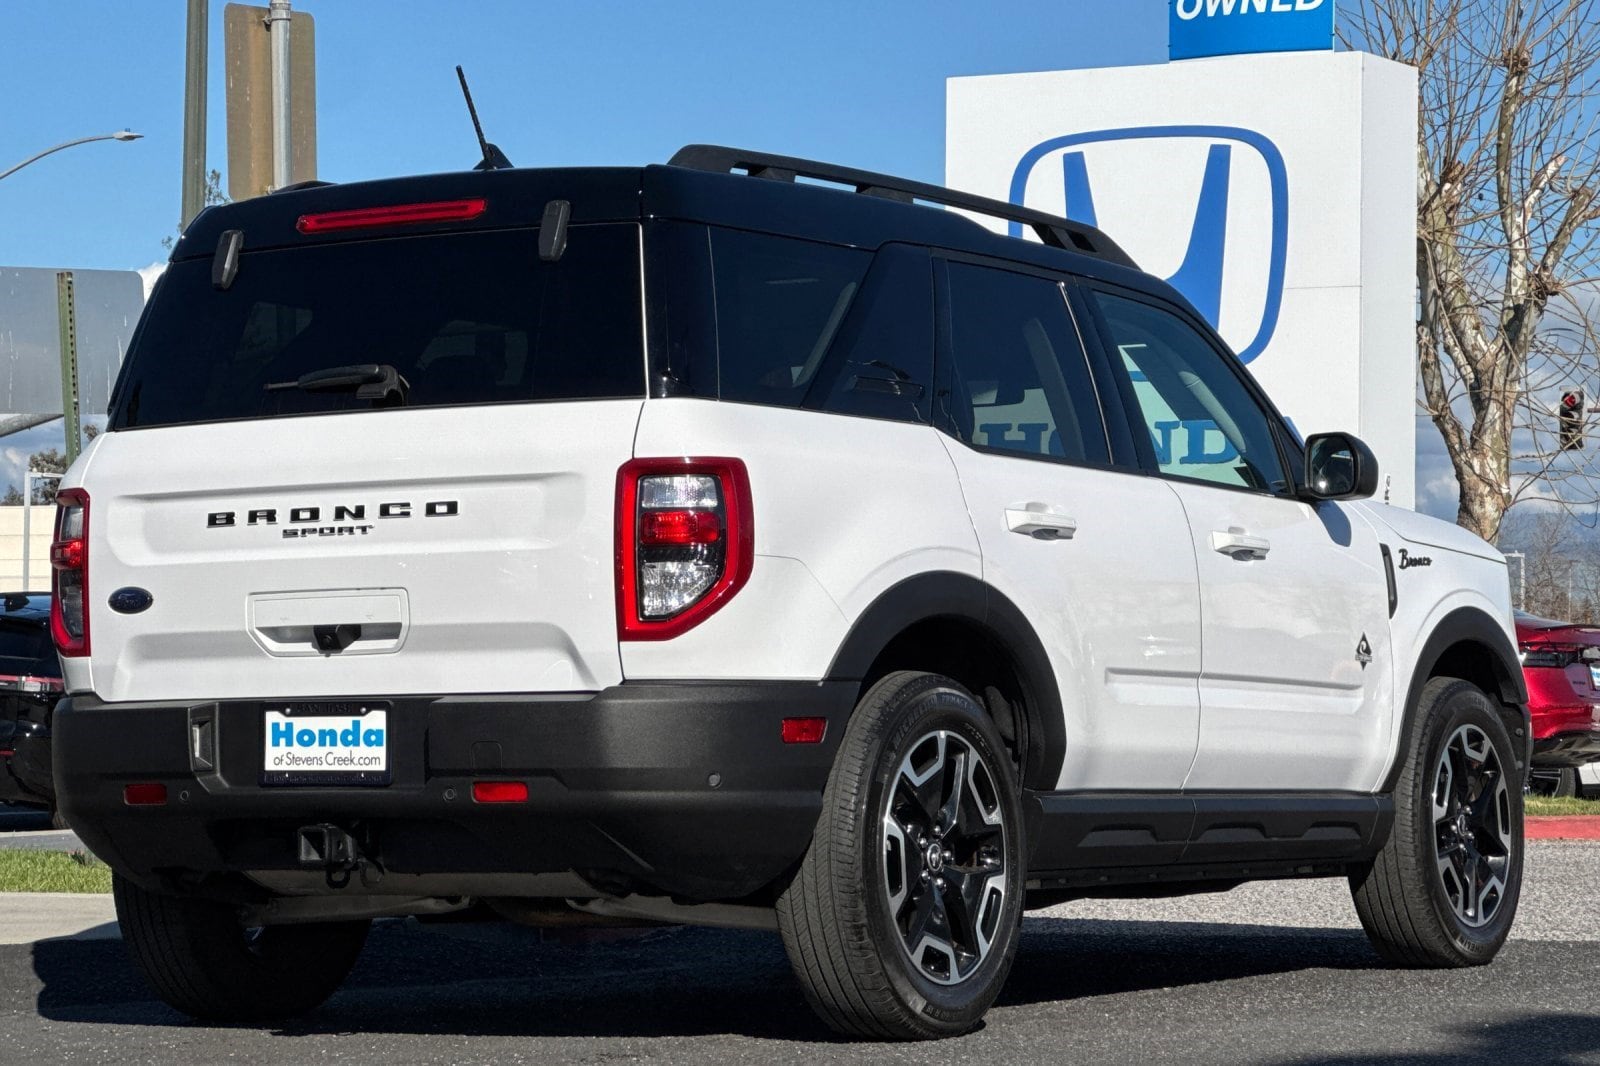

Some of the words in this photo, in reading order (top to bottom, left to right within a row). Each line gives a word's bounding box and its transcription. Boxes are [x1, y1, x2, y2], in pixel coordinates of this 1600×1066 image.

[207, 500, 459, 528] BRONCO
[282, 524, 375, 539] SPORT
[1398, 548, 1432, 570] Bronco
[271, 720, 384, 747] Honda
[273, 754, 285, 766] of
[286, 751, 323, 766] Stevens
[325, 750, 381, 766] Creek.com
